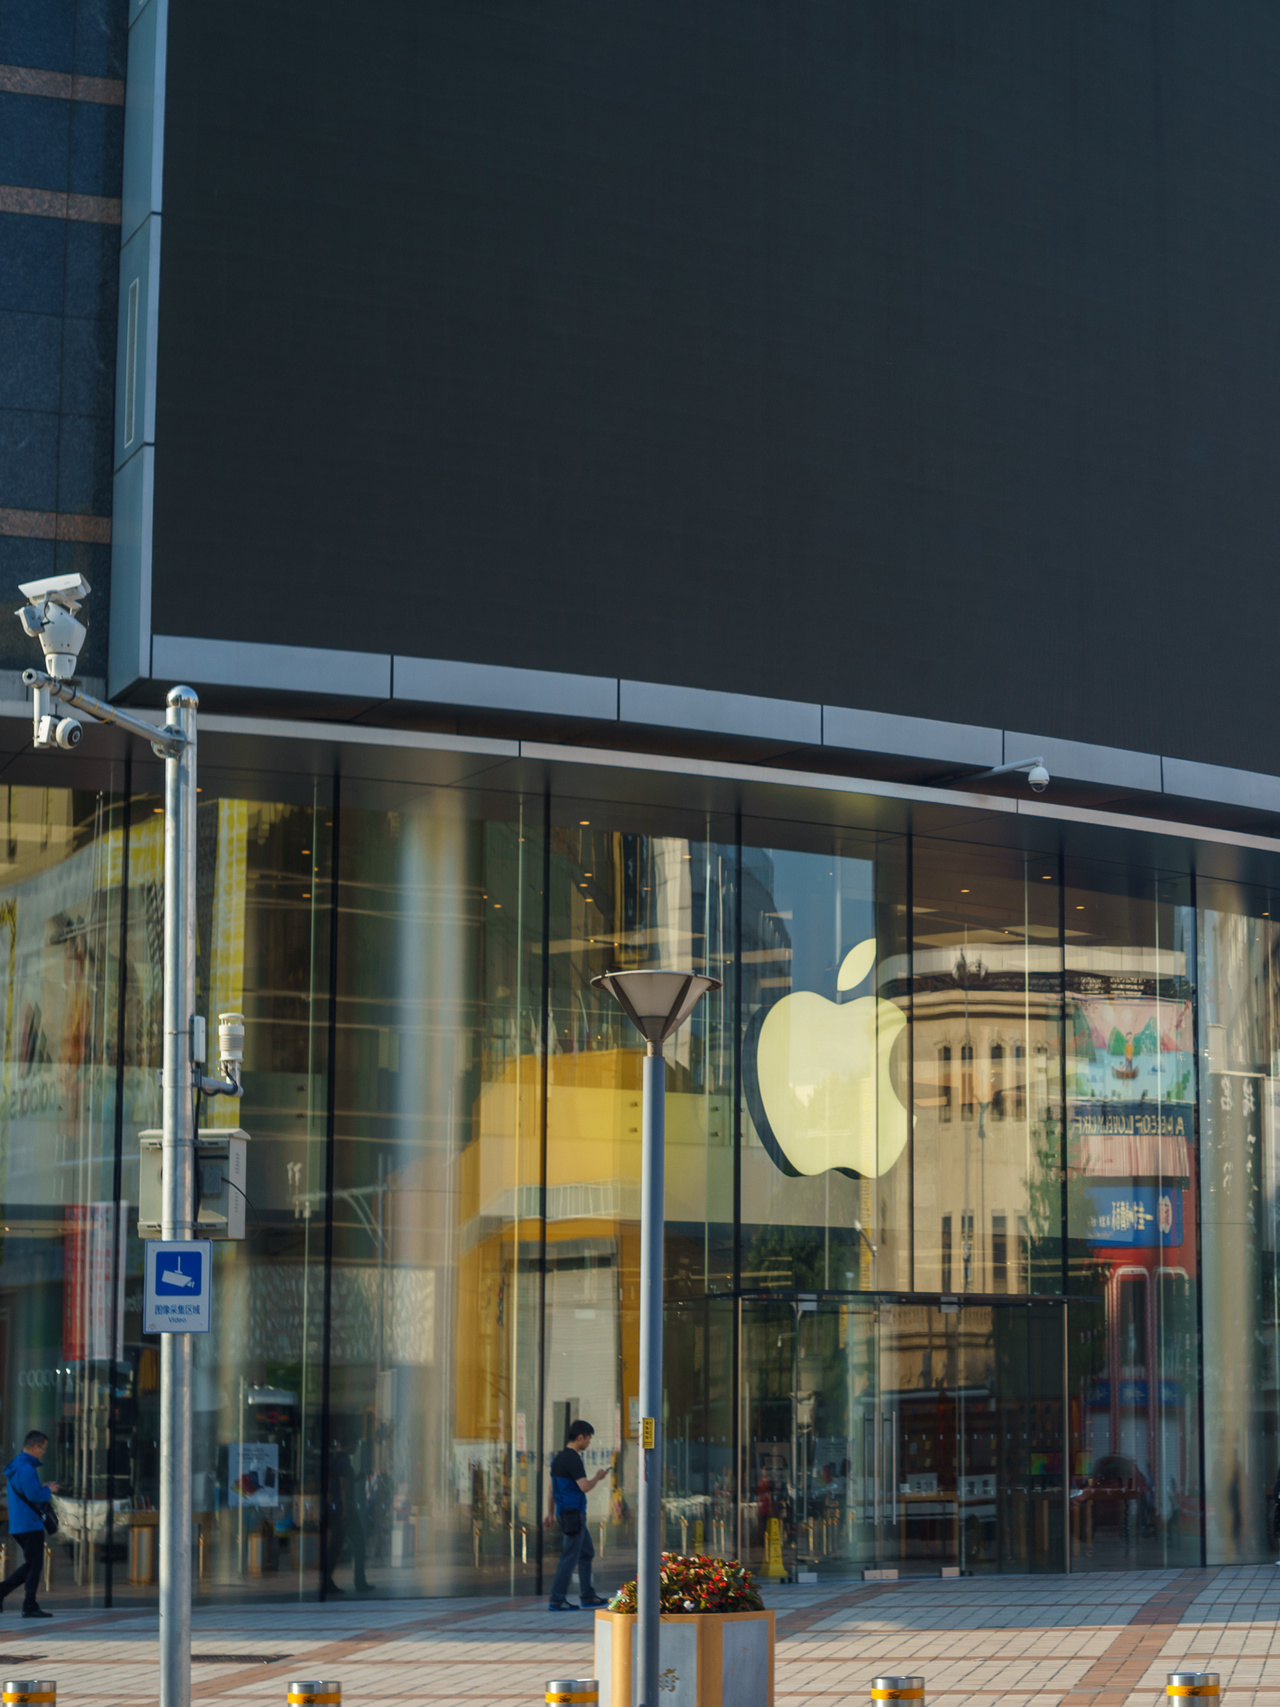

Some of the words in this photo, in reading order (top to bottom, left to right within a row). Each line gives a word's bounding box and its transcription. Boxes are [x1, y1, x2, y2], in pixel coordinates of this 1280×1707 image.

[154, 1304, 200, 1315] 图像采集区域
